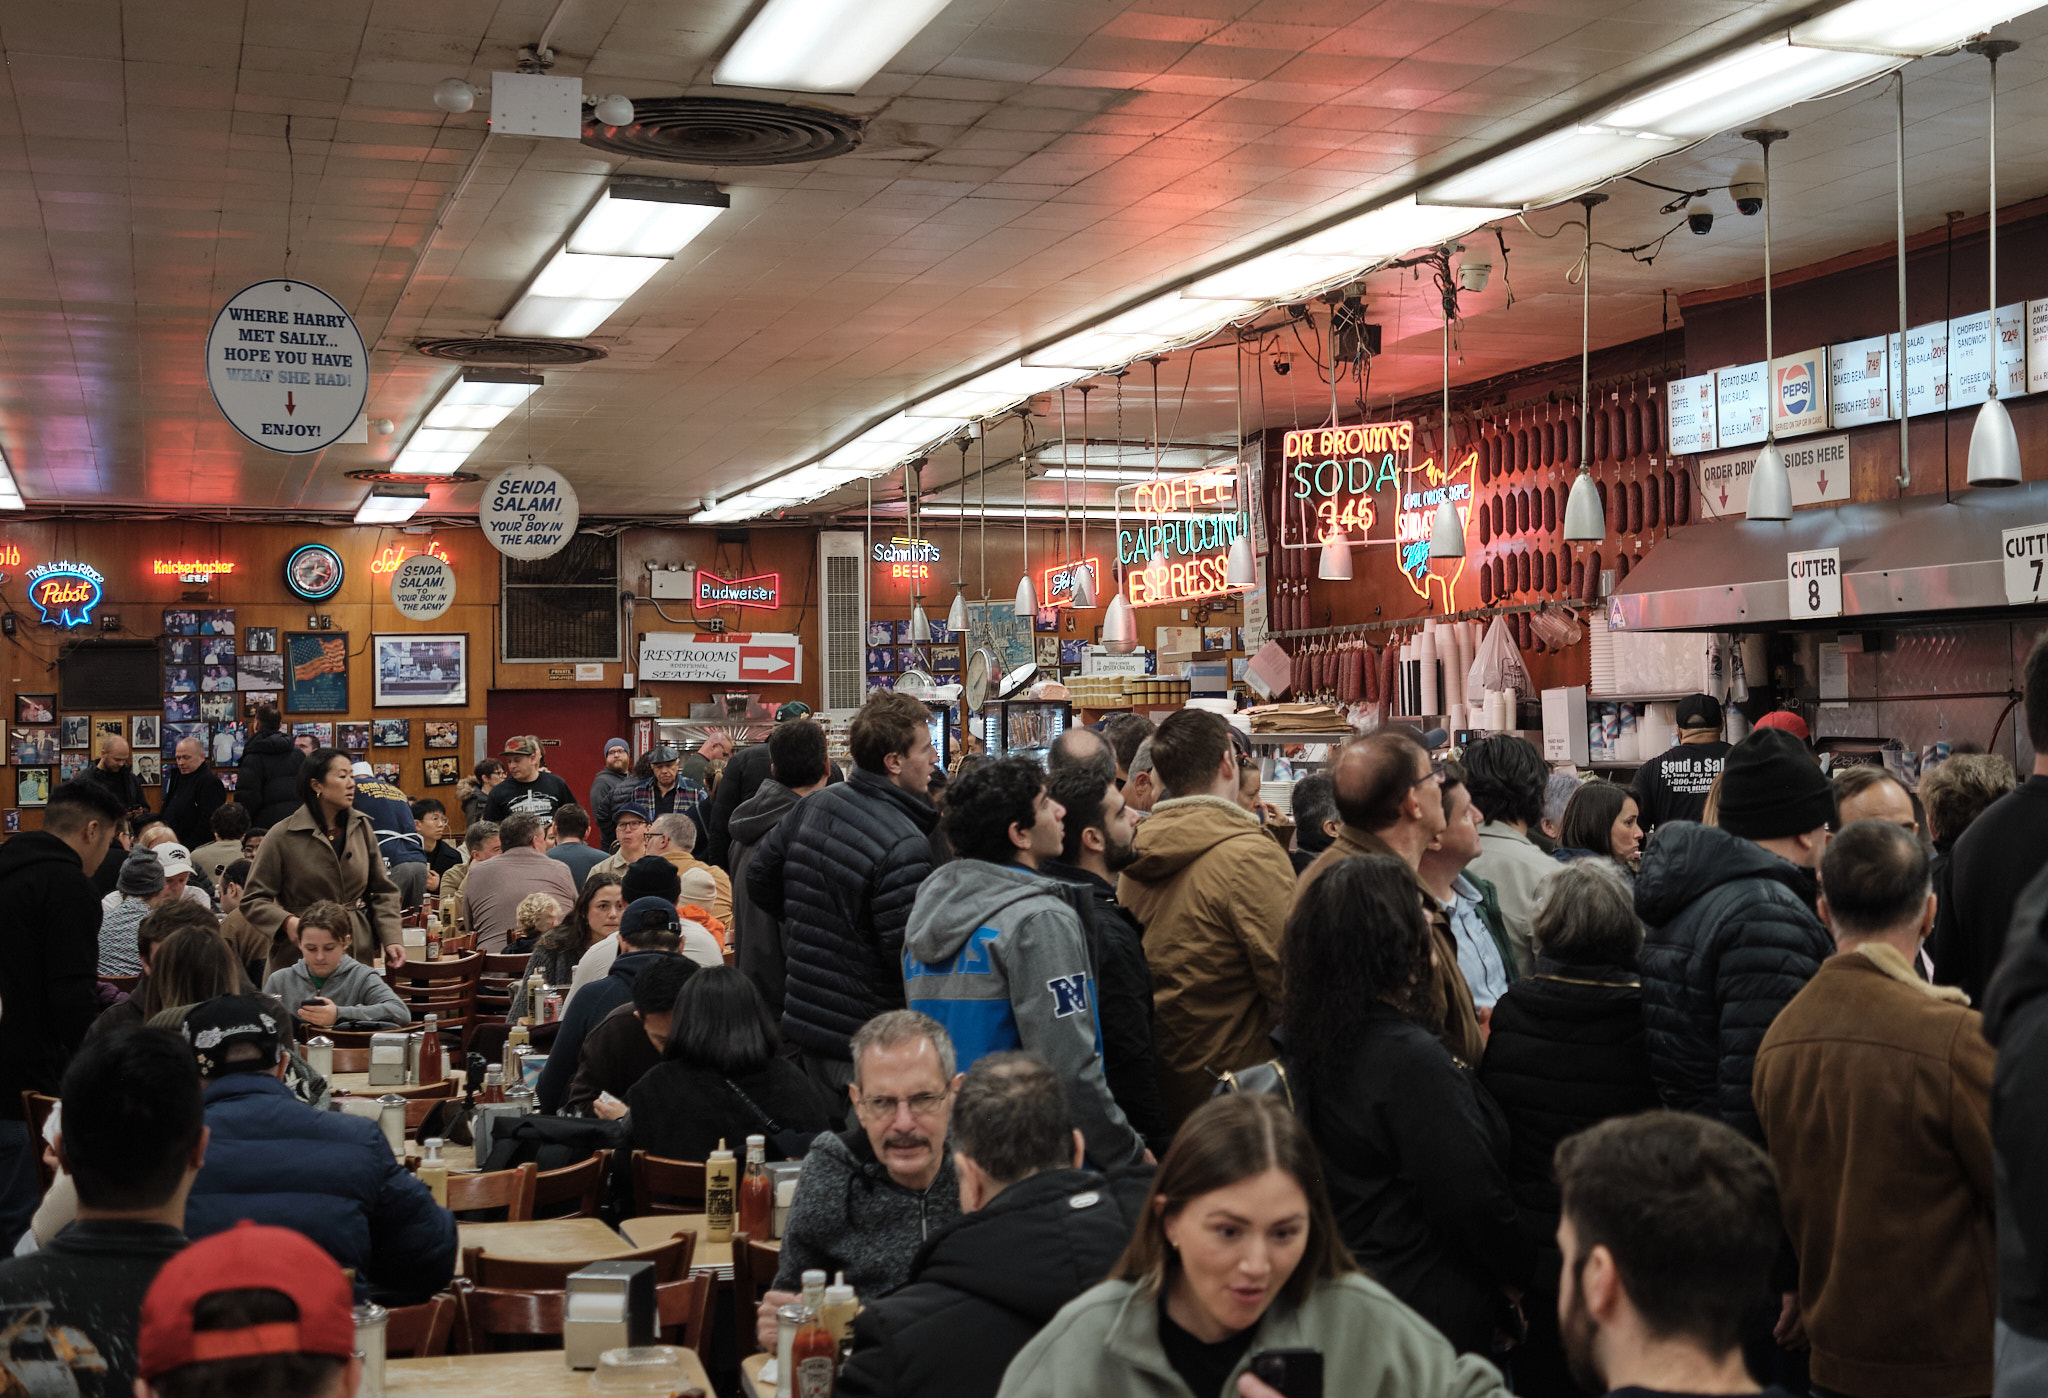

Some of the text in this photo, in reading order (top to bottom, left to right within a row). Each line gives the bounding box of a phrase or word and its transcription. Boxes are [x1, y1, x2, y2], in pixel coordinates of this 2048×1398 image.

[2033, 304, 2044, 314] ANY
[229, 307, 346, 328] WHERE HARRY
[1957, 321, 1983, 335] CHOPPED
[238, 328, 338, 347] MET SALLY...
[1907, 336, 1925, 348] SALAD
[1958, 334, 1987, 348] SANDWICH
[224, 348, 353, 367] HOPE YOU HAVE
[1833, 358, 1843, 370] HOT
[225, 367, 352, 387] WHAT SHE HAD!
[1721, 375, 1739, 389] POTATO
[1834, 372, 1851, 386] BAKED
[1960, 371, 1981, 385] CHEESE
[1671, 384, 1679, 395] TEA
[1783, 381, 1811, 398] PEPSI
[1908, 386, 1925, 396] SALAD
[1672, 398, 1689, 410] COFFEE
[1721, 394, 1732, 405] MAC
[1834, 401, 1855, 415] FRENCH
[1672, 414, 1696, 427] ESPRESSO
[1775, 422, 1789, 432] SERVED
[1789, 421, 1795, 429] ON
[1802, 419, 1807, 427] OR
[261, 423, 321, 437] ENJOY!
[1722, 425, 1735, 437] COLE
[1286, 432, 1314, 457] DR
[1704, 464, 1733, 482] ORDER
[1784, 450, 1814, 469] SIDES
[1817, 444, 1844, 464] HERE
[1294, 453, 1399, 499] SODA
[1135, 469, 1233, 514] COFFEE
[492, 496, 562, 512] SALAMI
[519, 513, 536, 522] TO
[1318, 497, 1374, 544] 345
[490, 521, 564, 532] YOUR BOY IN
[500, 534, 561, 545] THE ARMY
[154, 559, 235, 574] Knickerbocker
[893, 564, 928, 578] BEER
[1791, 558, 1837, 579] CUTTER
[1129, 554, 1229, 605] ESPRESS
[2030, 558, 2044, 592] 7
[399, 577, 444, 588] SALAMI
[41, 582, 92, 604] Pabst
[397, 594, 417, 602] YOUR
[419, 594, 437, 602] BOY
[701, 583, 776, 601] Budweiser
[1808, 580, 1820, 611] 8
[403, 603, 445, 611] THE ARMY
[643, 649, 738, 663] RESTROOMS
[652, 669, 726, 680] SEATING
[1661, 758, 1691, 775] Send
[1694, 761, 1701, 772] a
